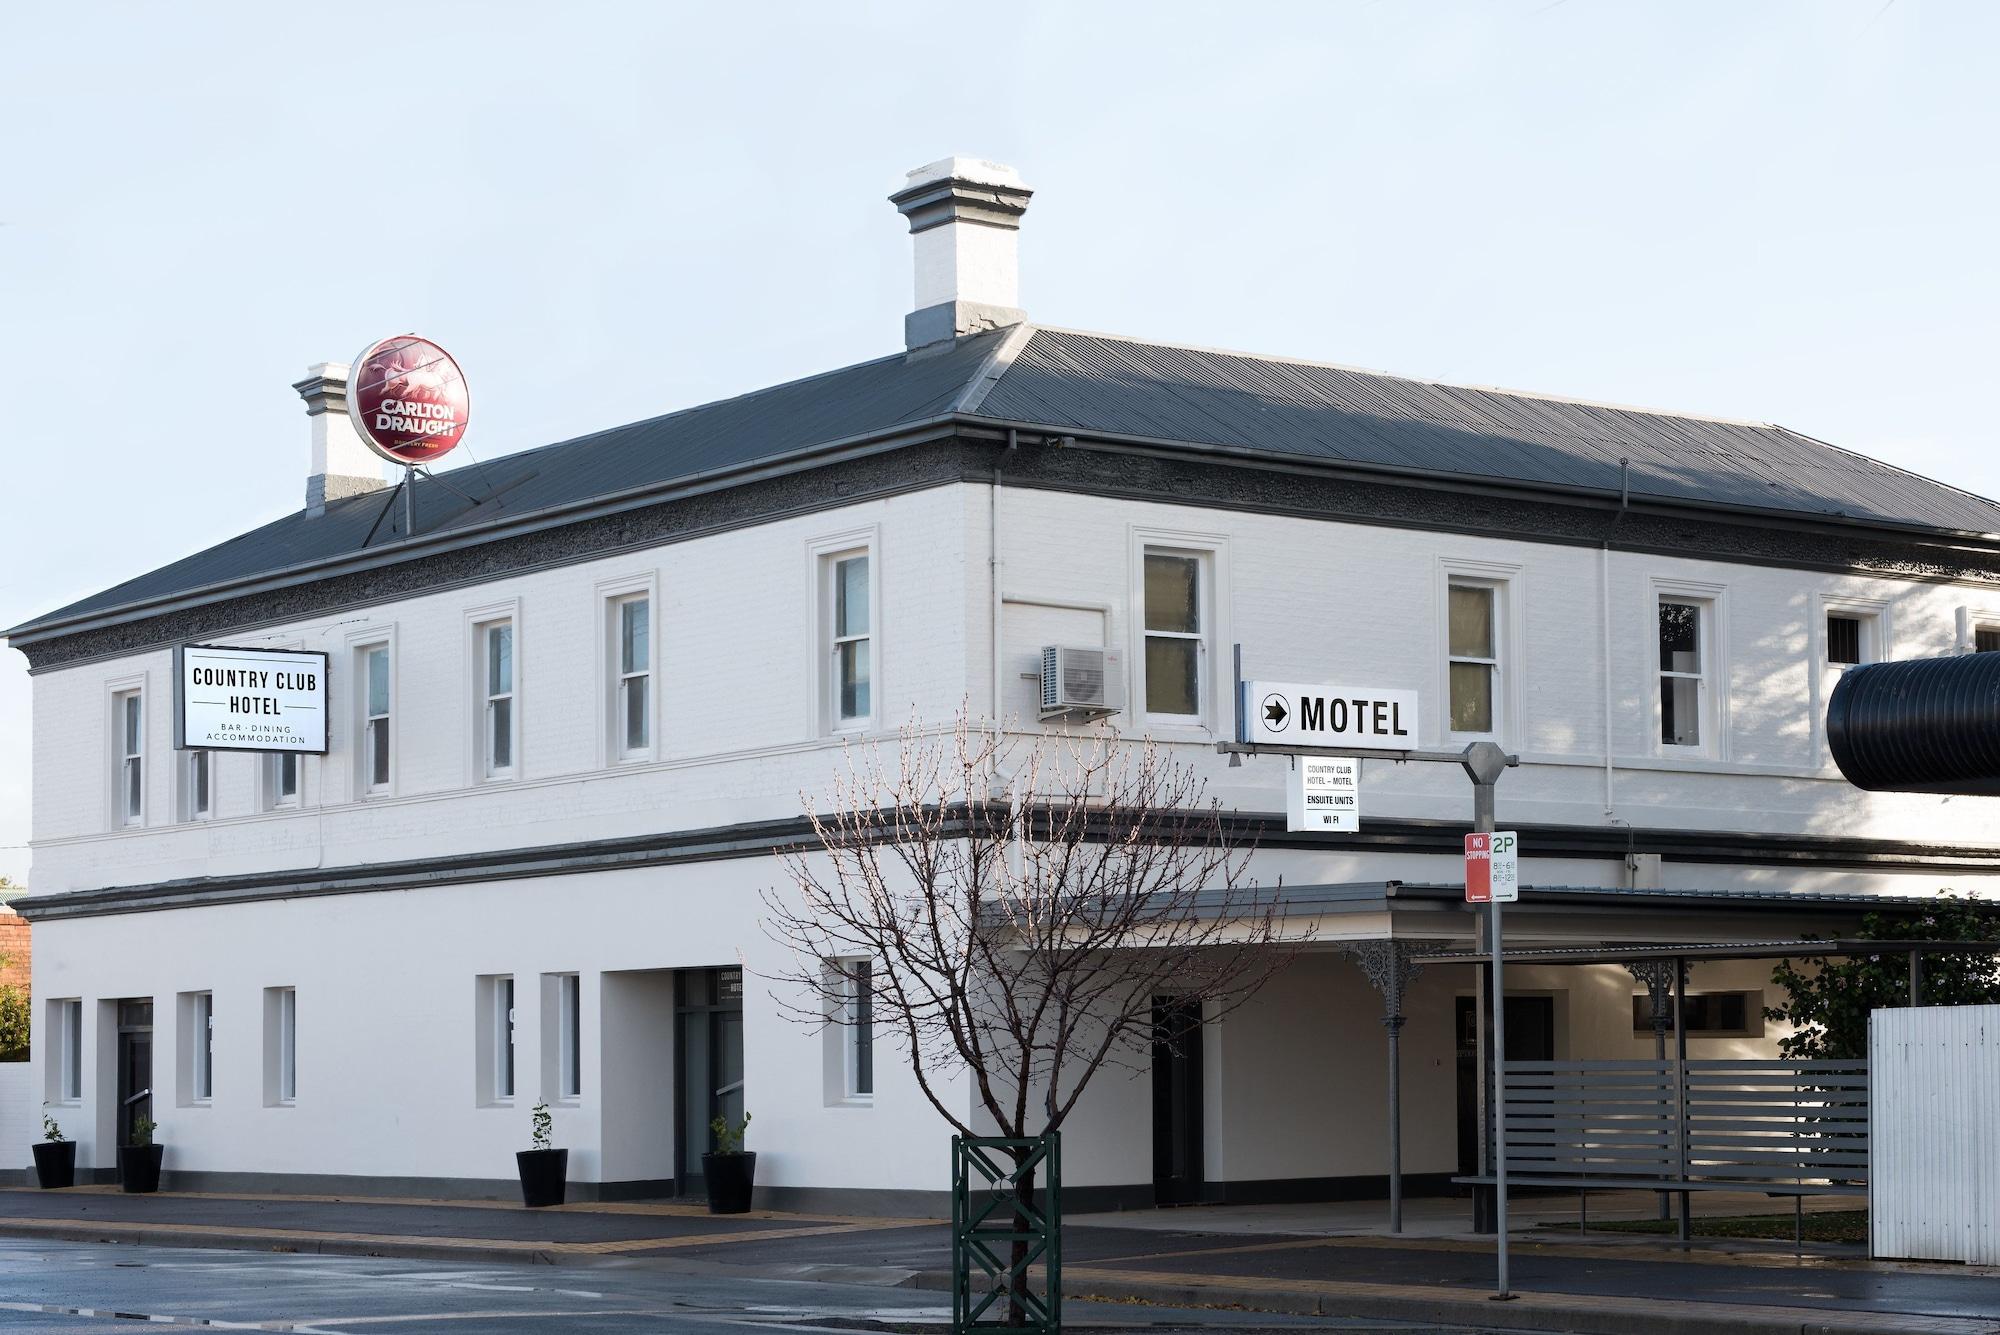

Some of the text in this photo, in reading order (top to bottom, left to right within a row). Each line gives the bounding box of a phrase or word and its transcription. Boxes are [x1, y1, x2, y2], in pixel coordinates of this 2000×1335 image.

[380, 398, 455, 420] CARLTON
[375, 413, 457, 437] DRAUGHT
[193, 667, 316, 691] COUNTRY CLUB
[230, 696, 281, 715] HOTEL
[1300, 696, 1408, 736] MOTEL
[221, 723, 291, 733] BAR DINING
[206, 733, 305, 744] ACCOMMODATION
[1307, 765, 1352, 774] COUNTRY CLUB
[1307, 776, 1326, 785] HOTEL
[1332, 777, 1353, 786] MOTEL
[1307, 795, 1354, 805] ENSUITE UNITS
[1472, 837, 1483, 848] NO
[1493, 836, 1514, 854] 2P
